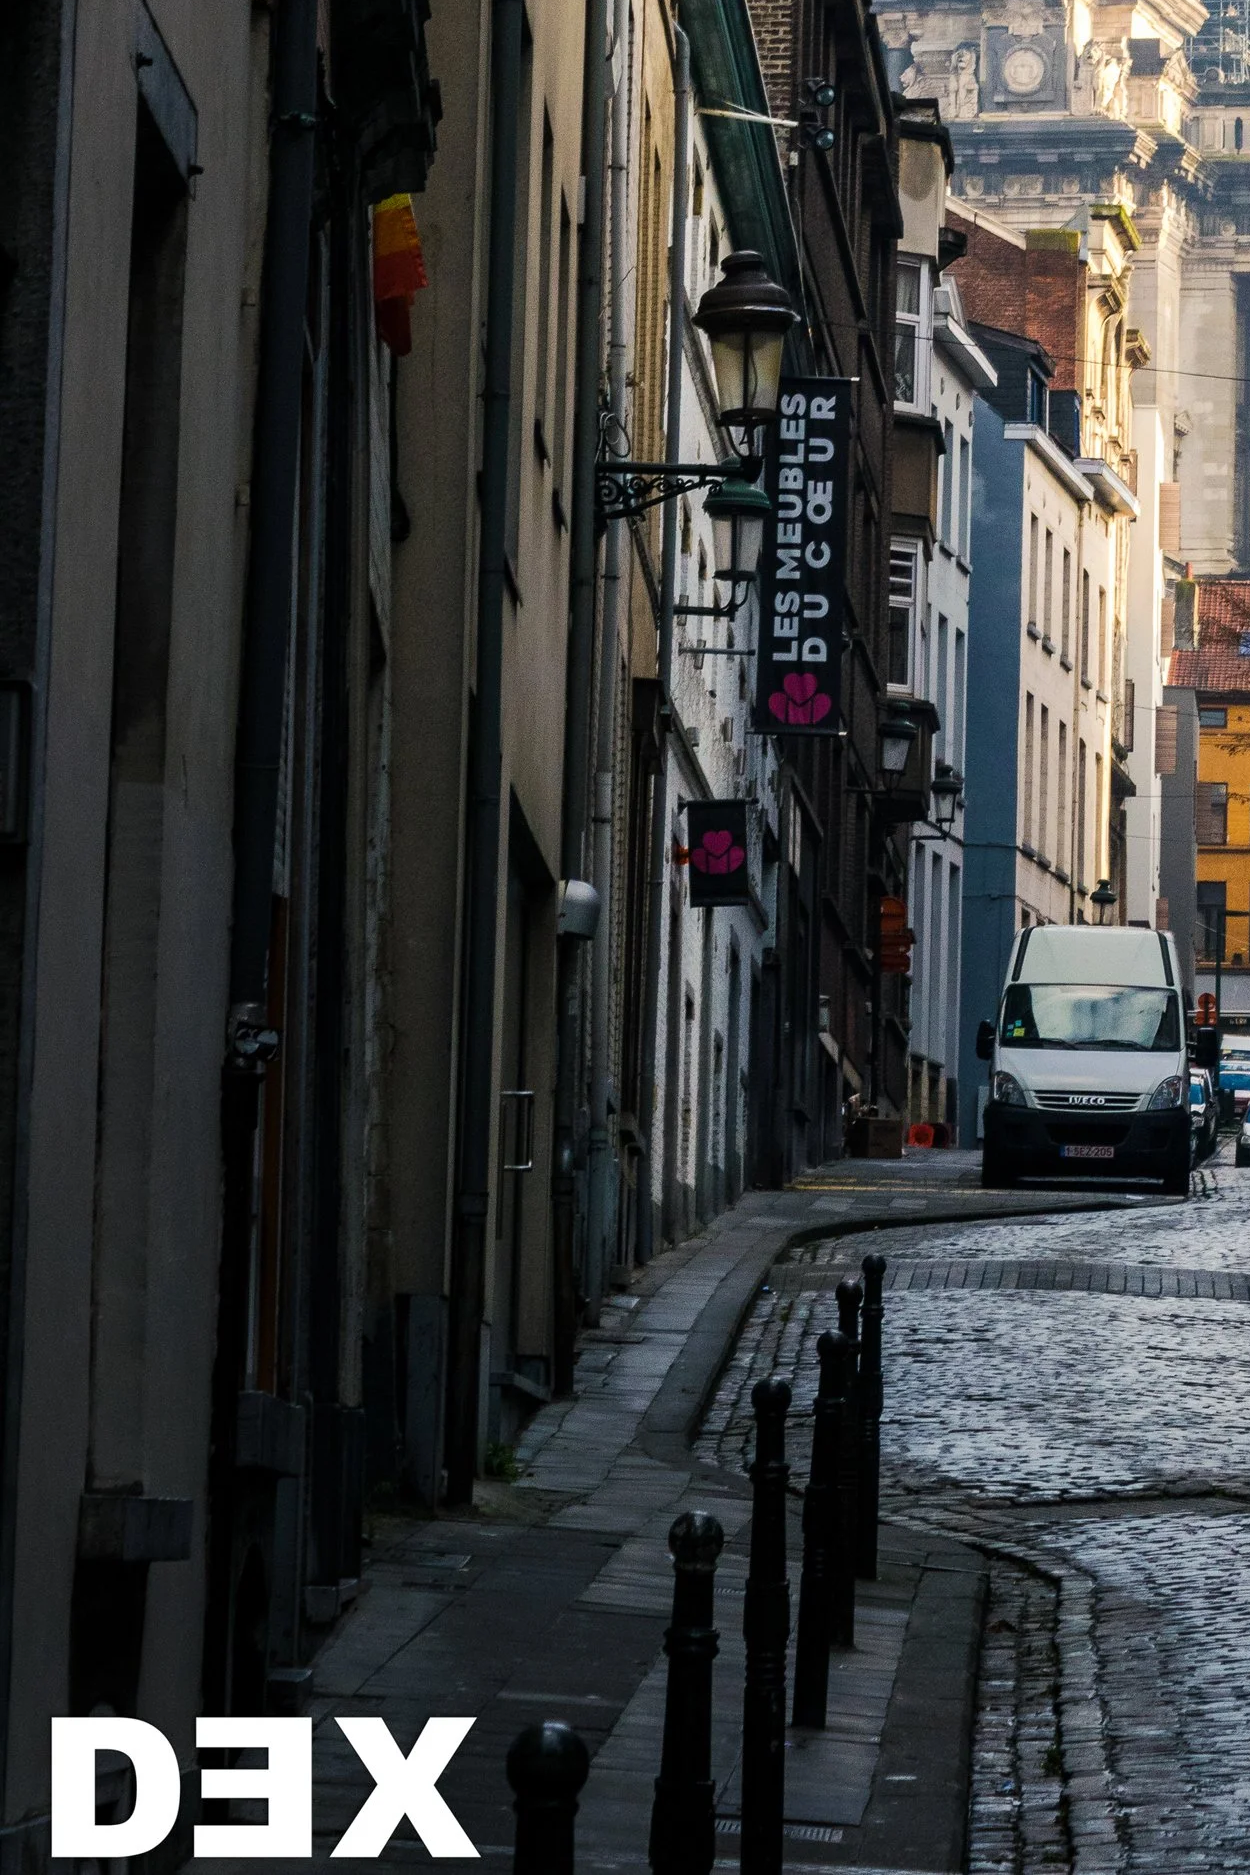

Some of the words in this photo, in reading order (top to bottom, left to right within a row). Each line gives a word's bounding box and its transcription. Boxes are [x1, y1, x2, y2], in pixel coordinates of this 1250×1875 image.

[776, 393, 807, 579] MEUBLES
[805, 395, 837, 570] CŒUR
[772, 590, 801, 662] LES
[802, 594, 829, 662] DU
[1069, 1095, 1106, 1106] IVECO
